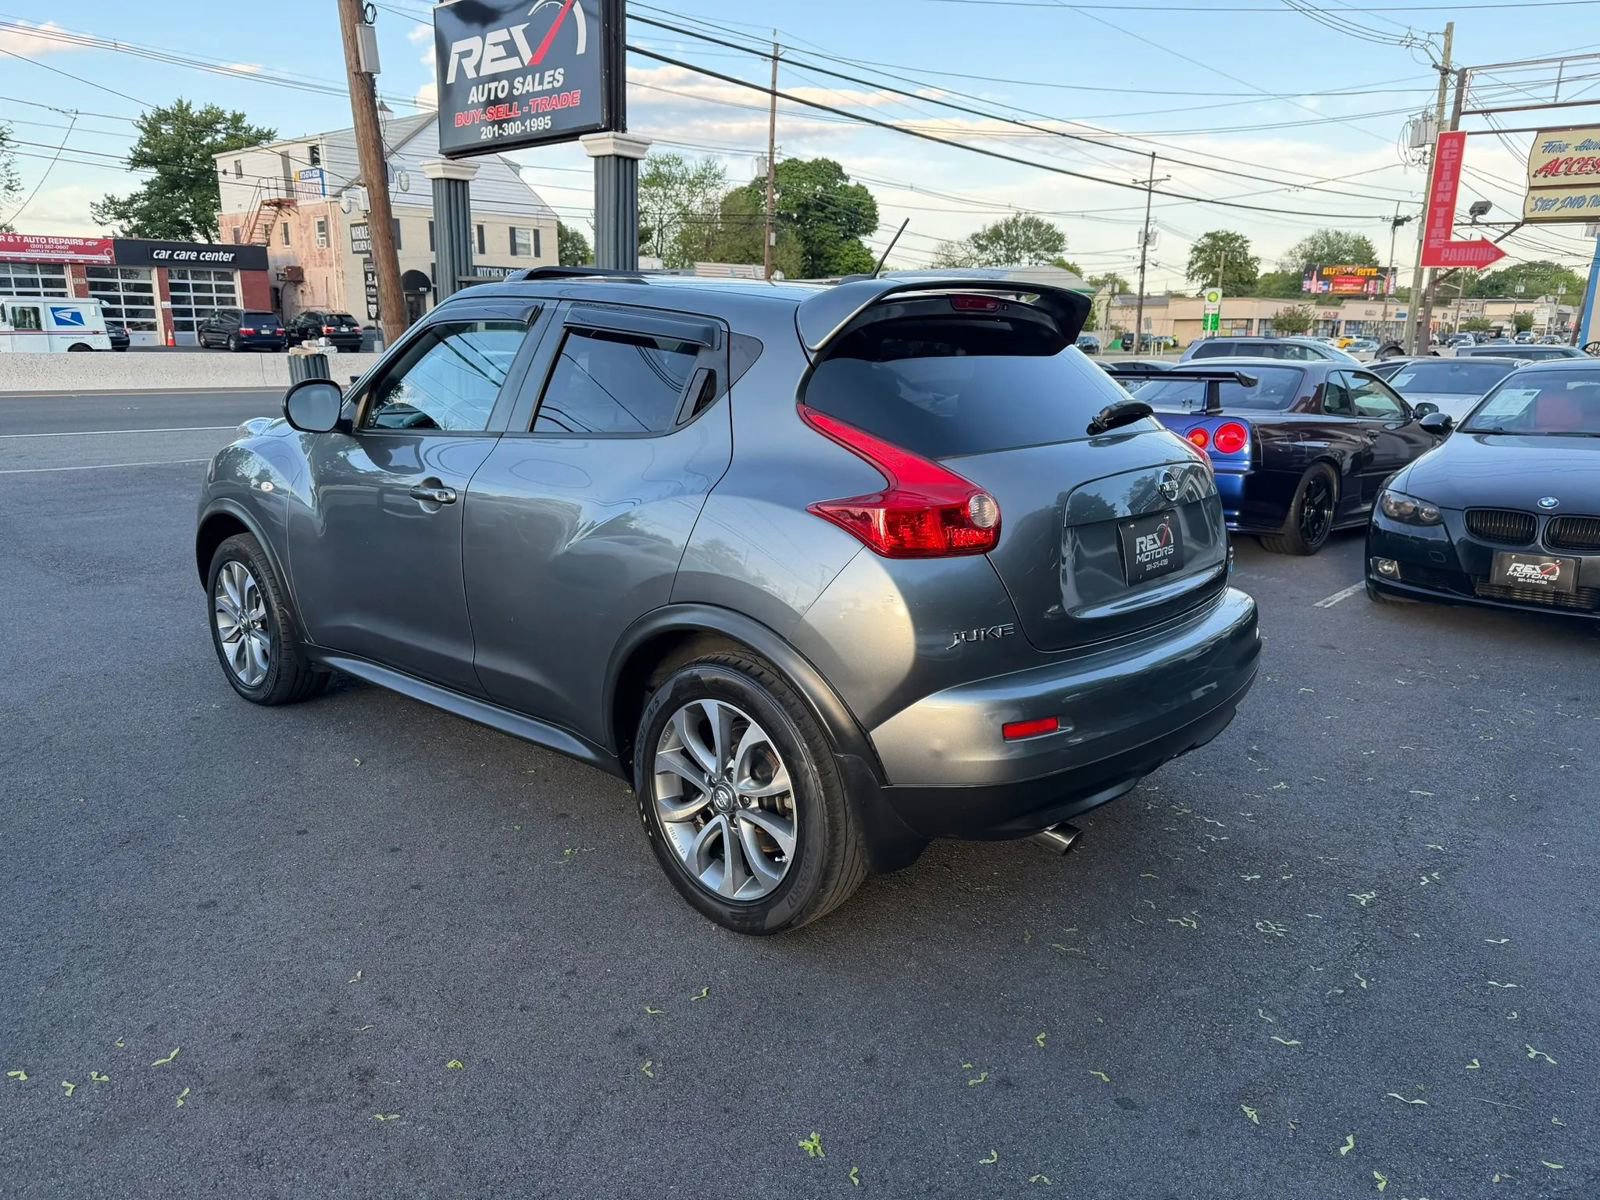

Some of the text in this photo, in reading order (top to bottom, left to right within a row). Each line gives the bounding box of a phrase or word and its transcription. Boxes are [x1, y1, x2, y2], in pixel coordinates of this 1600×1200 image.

[468, 68, 565, 105] AUTO SALES
[481, 116, 552, 140] 201-300-1995
[48, 238, 84, 246] REPAIRS
[153, 250, 235, 262] car care center
[1440, 248, 1497, 262] PARKING
[1136, 545, 1174, 564] MOTORS
[1506, 571, 1558, 581] MOTORS
[945, 623, 1015, 650] JUKE
